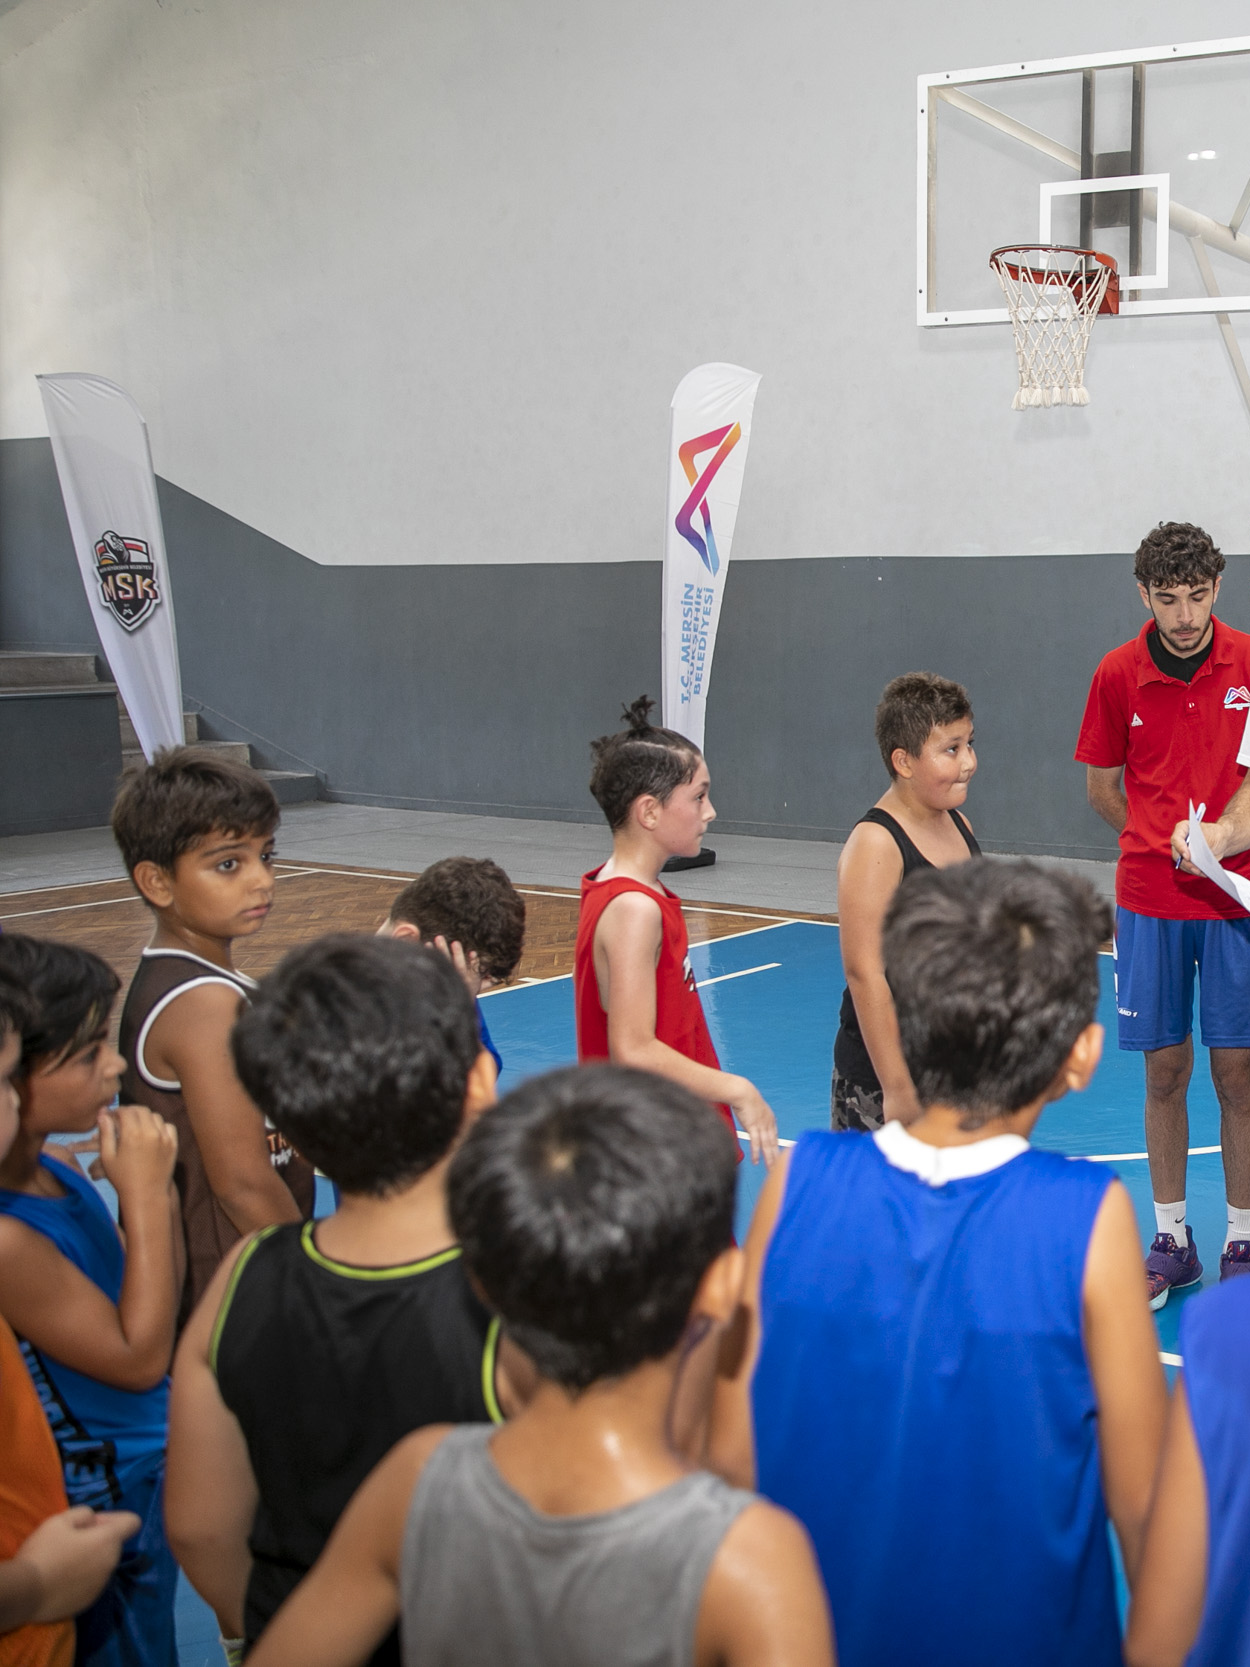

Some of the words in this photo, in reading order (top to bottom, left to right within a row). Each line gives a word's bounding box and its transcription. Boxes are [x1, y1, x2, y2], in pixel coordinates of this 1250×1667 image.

[103, 572, 156, 601] MSK
[681, 583, 695, 663] MERSİN
[693, 587, 715, 695] BELEDİYESİ
